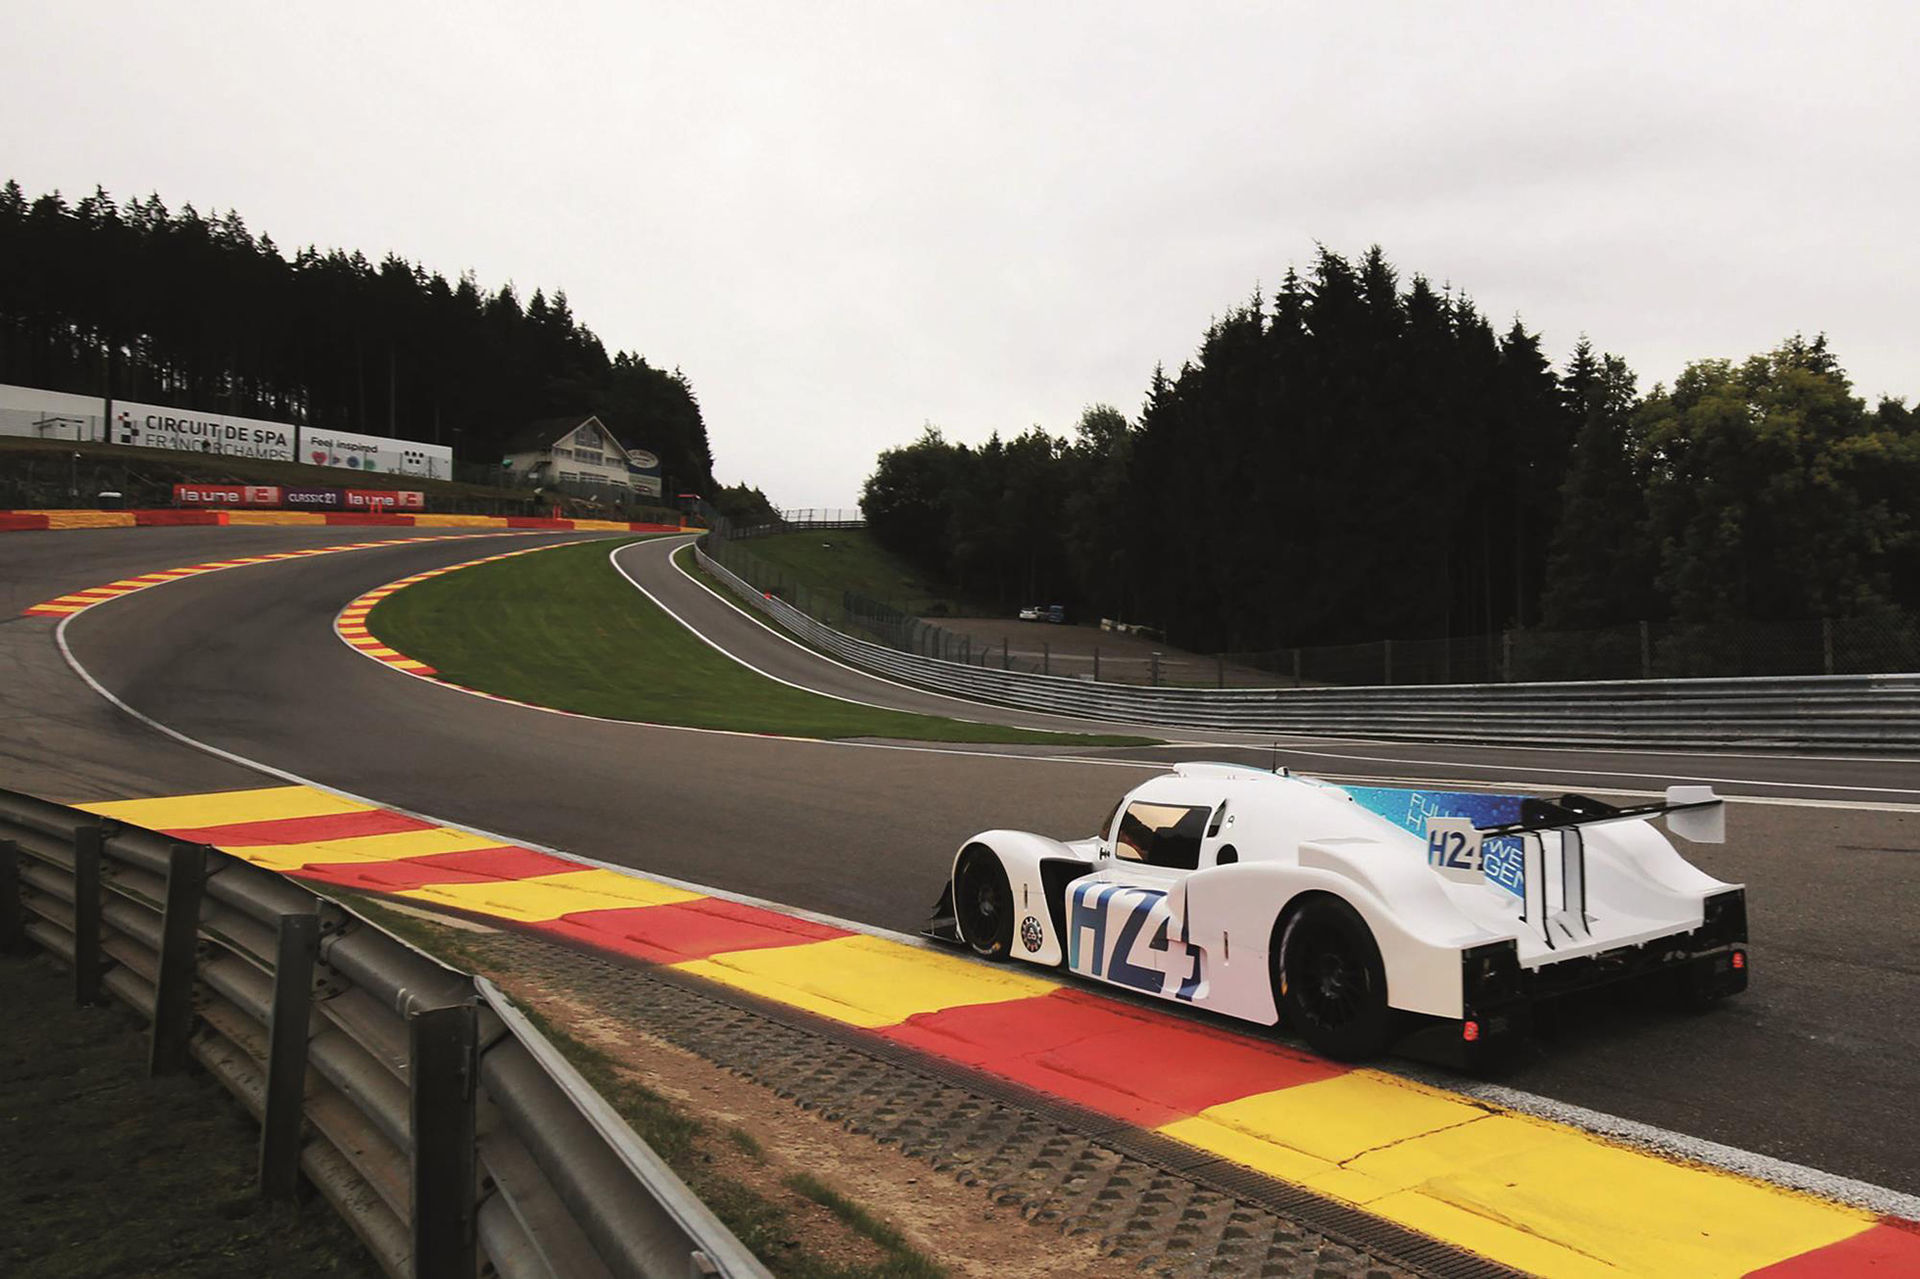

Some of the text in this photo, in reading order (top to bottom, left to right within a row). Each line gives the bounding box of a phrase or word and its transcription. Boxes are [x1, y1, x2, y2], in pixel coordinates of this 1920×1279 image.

[146, 415, 288, 447] CIRCUIT DE SPA
[310, 437, 378, 454] Feel inspired
[1428, 830, 1484, 871] H24
[1070, 881, 1202, 1002] H24
